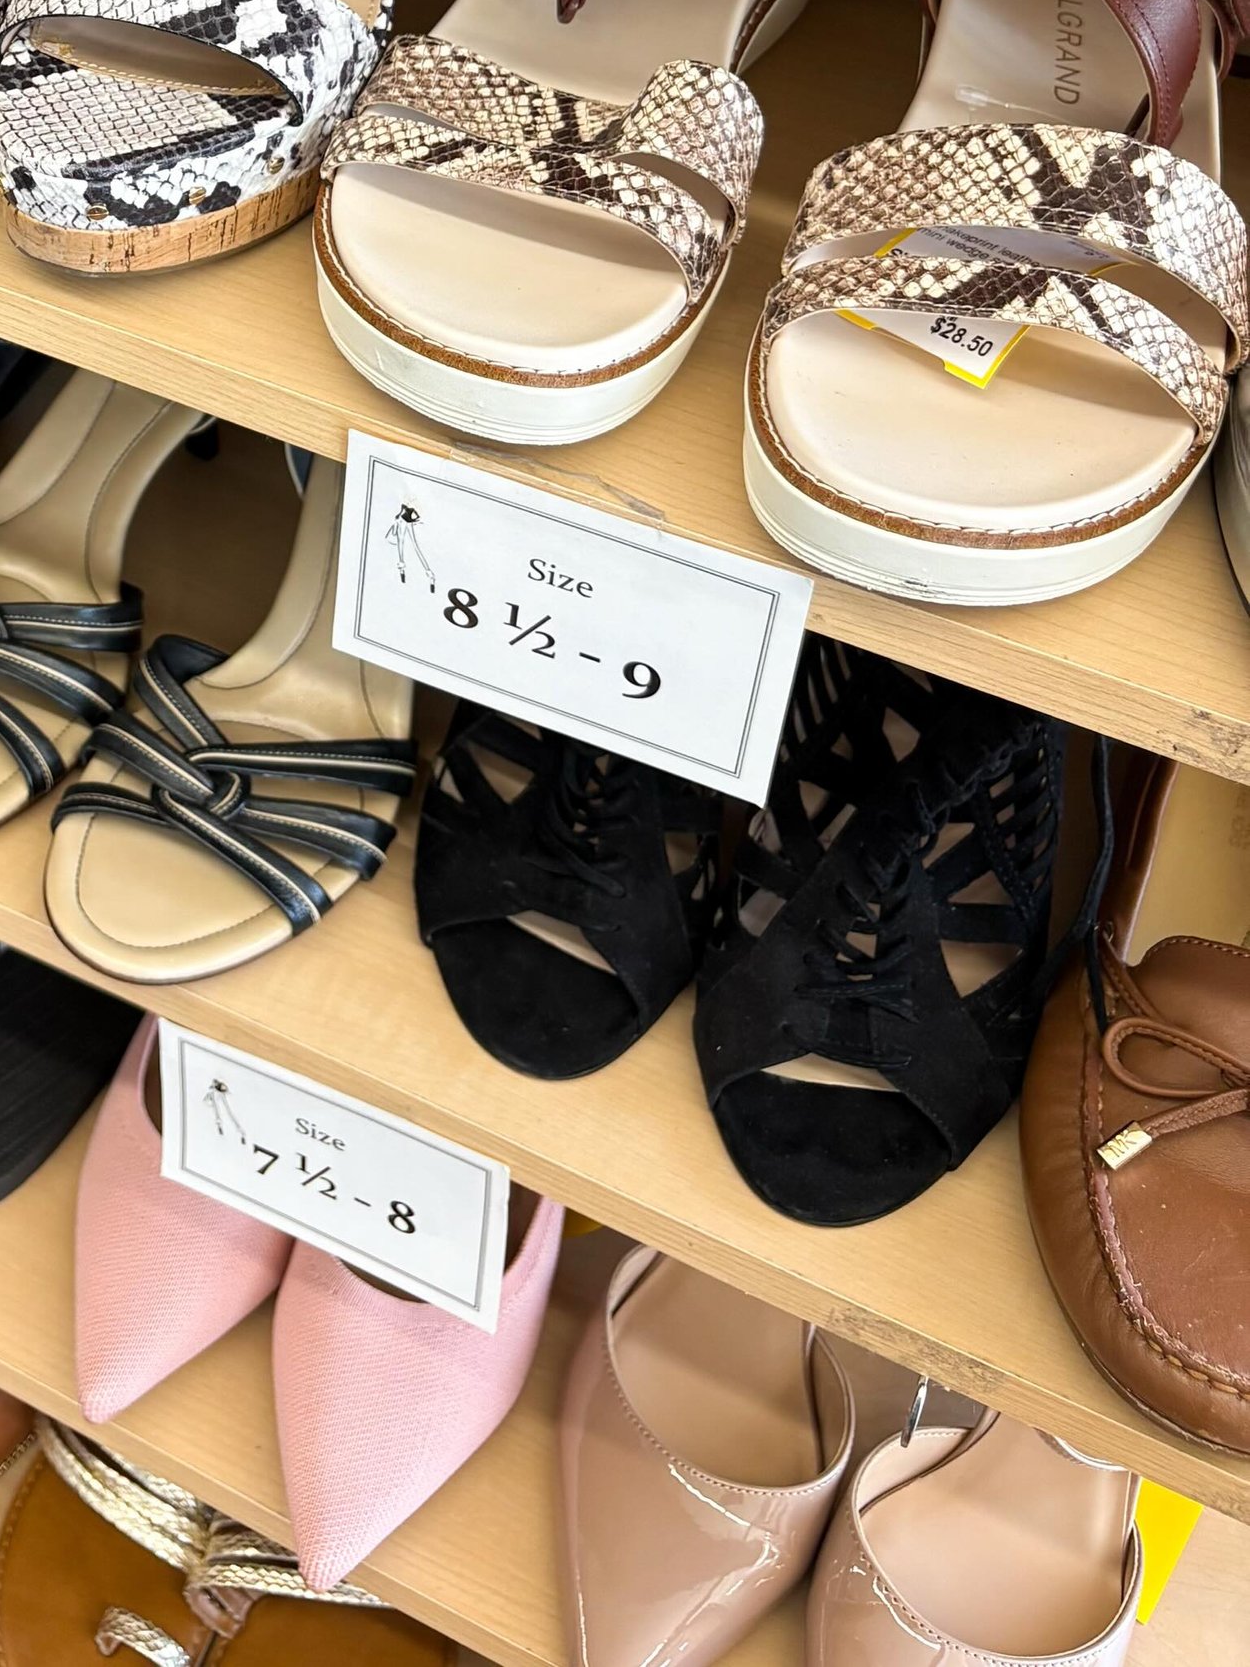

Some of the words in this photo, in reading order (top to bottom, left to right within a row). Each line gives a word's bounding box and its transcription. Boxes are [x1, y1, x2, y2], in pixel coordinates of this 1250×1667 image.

[936, 226, 1000, 251] nakeprint
[998, 245, 1040, 268] leathe
[946, 237, 990, 260] wedge
[930, 317, 994, 357] $28.50
[527, 558, 594, 599] Size
[443, 587, 479, 629] 8
[622, 660, 662, 699] 9
[295, 1117, 346, 1152] Size
[253, 1143, 280, 1175] 7
[387, 1200, 417, 1235] 8
